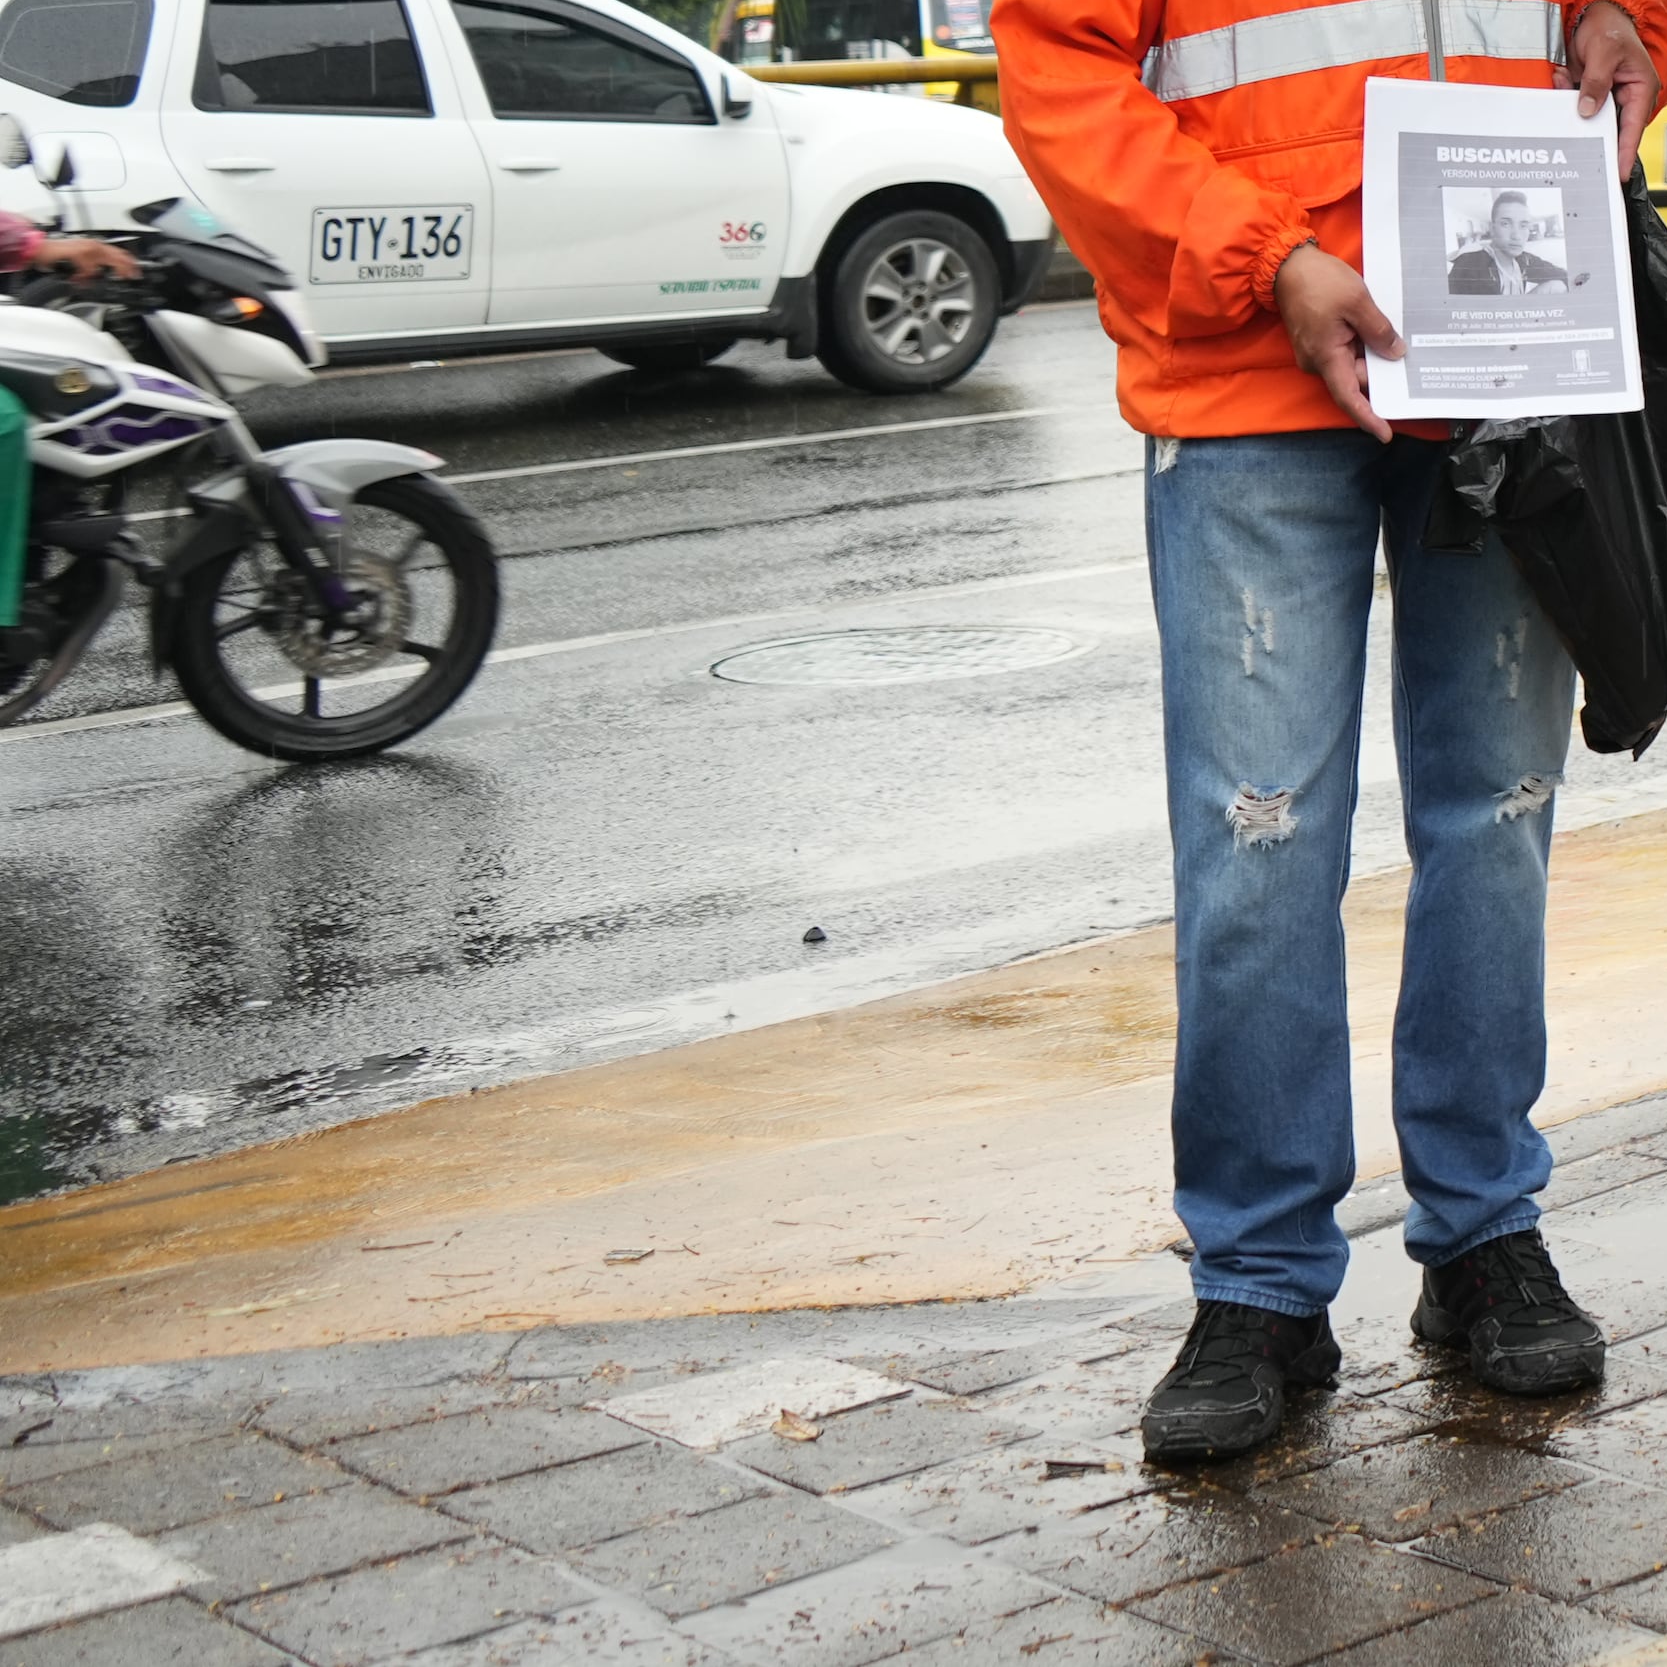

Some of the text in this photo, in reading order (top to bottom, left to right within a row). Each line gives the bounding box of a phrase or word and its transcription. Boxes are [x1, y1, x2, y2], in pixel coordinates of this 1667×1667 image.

[1436, 146, 1568, 164] BUSCAMOS A
[1441, 169, 1580, 180] YERSON DAVID QUINTERO LARA
[322, 215, 463, 261] GTY 136
[358, 264, 424, 280] ENVIGADO
[1452, 310, 1468, 320] FUE
[1469, 310, 1494, 320] VISTO
[1495, 310, 1513, 319] POR
[1514, 309, 1547, 319] ÚLTIMA
